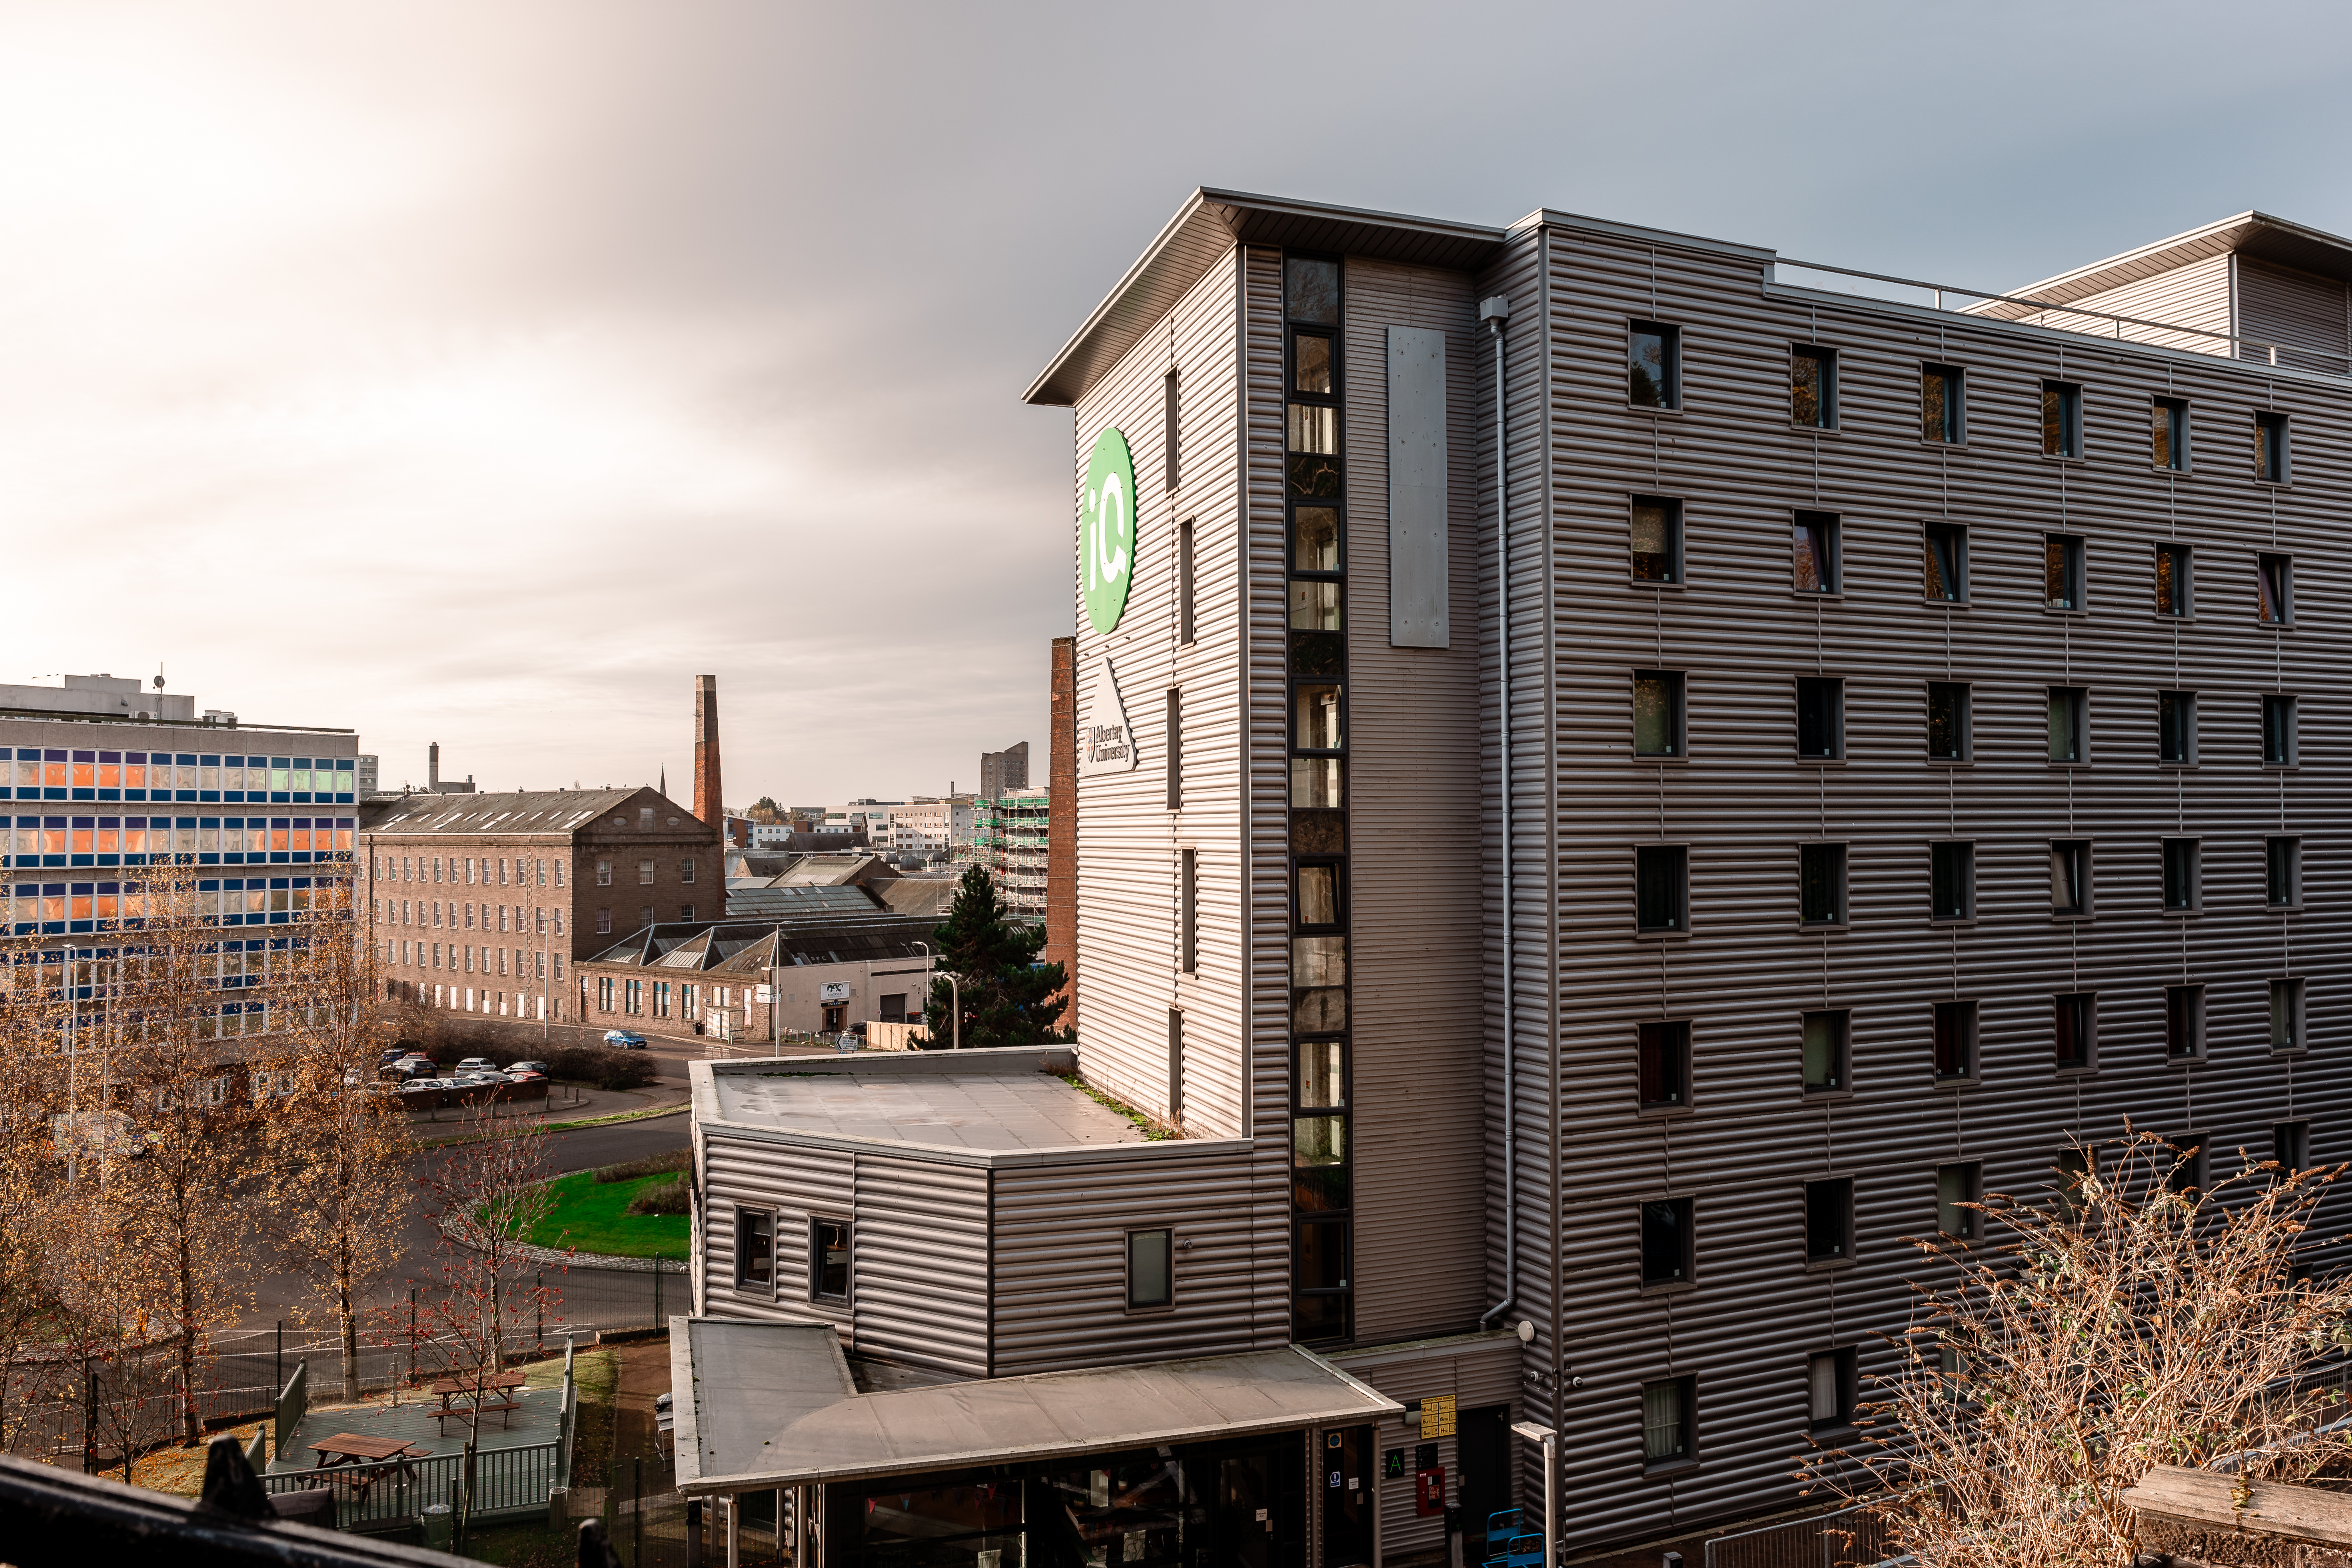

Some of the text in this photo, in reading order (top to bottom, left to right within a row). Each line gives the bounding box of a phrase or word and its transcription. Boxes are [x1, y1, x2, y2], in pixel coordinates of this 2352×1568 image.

[1096, 724, 1123, 743] Abertay
[1096, 742, 1130, 762] University
[1390, 1454, 1401, 1472] A
